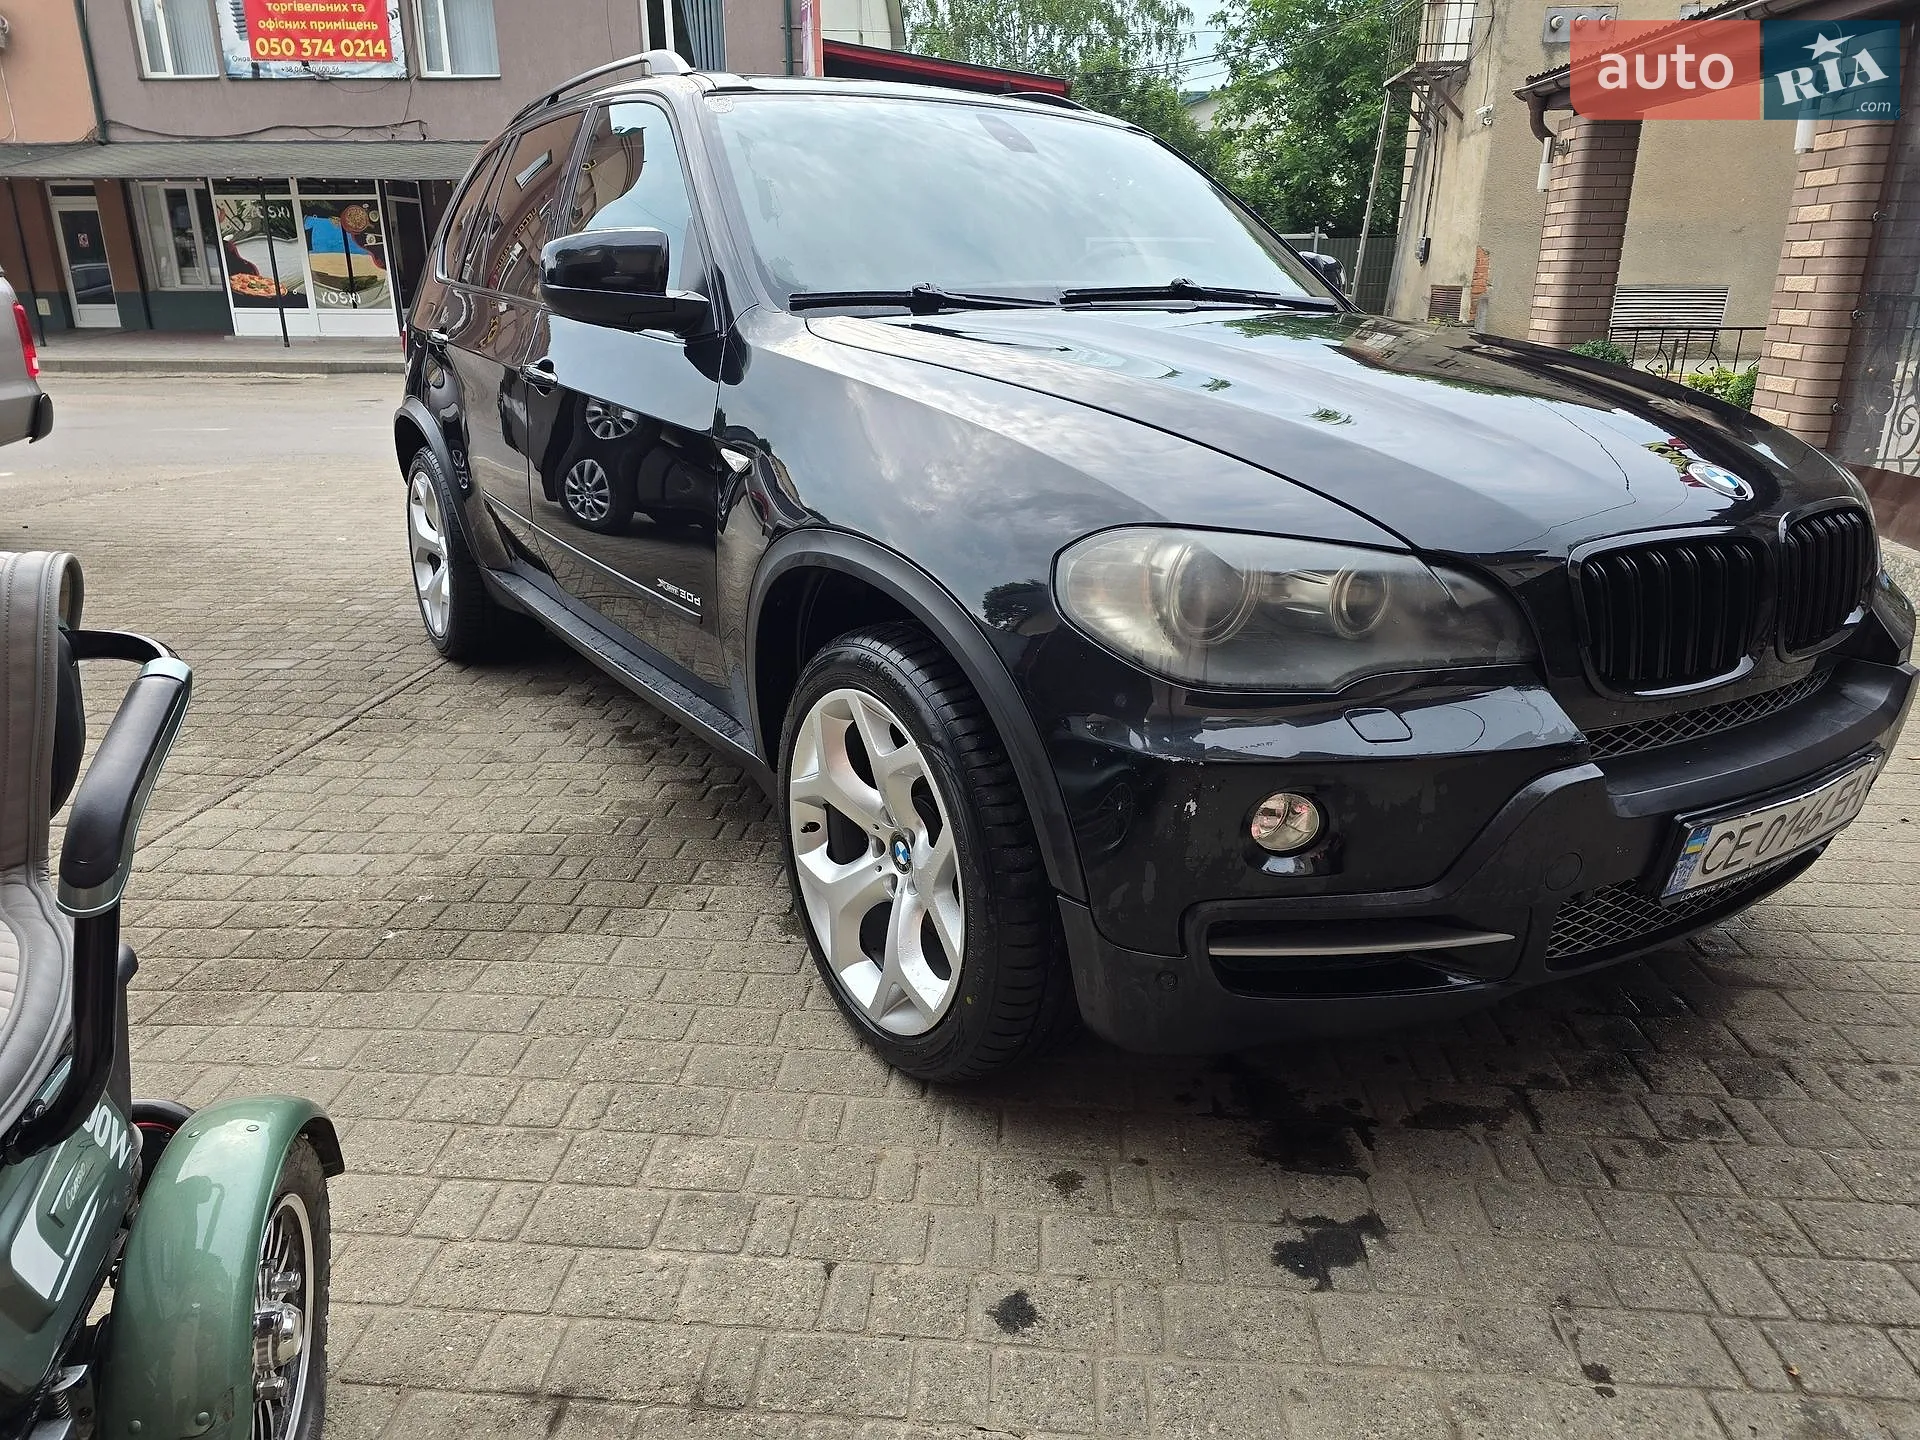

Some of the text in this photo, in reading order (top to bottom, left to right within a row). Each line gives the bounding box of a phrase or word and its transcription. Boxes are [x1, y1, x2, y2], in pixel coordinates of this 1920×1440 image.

[266, 0, 366, 13] торгівельних та
[258, 18, 378, 32] офісних приміщень
[255, 37, 388, 58] 050 374 0214
[1701, 821, 1763, 876] CE
[1755, 791, 1835, 857] 0146
